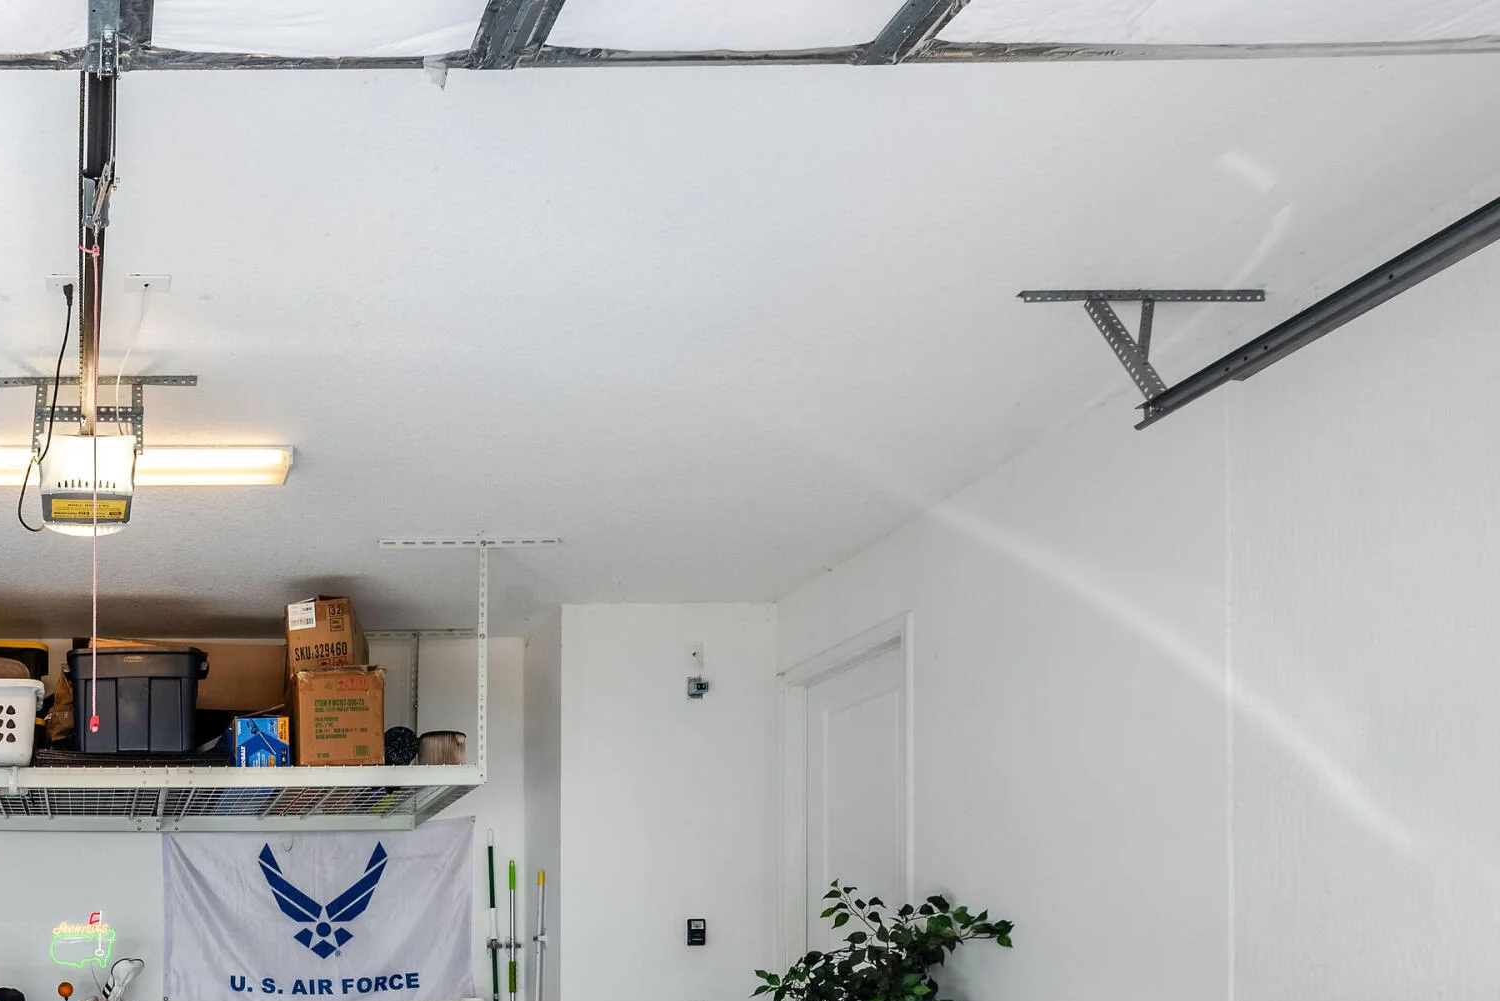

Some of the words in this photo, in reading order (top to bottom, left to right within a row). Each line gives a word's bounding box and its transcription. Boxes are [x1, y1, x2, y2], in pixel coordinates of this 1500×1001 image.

[330, 605, 341, 616] 32
[294, 641, 348, 662] SKU:329460
[230, 975, 253, 992] U.
[261, 978, 284, 994] S.
[291, 979, 334, 995] AIR
[341, 972, 421, 995] FORCE
